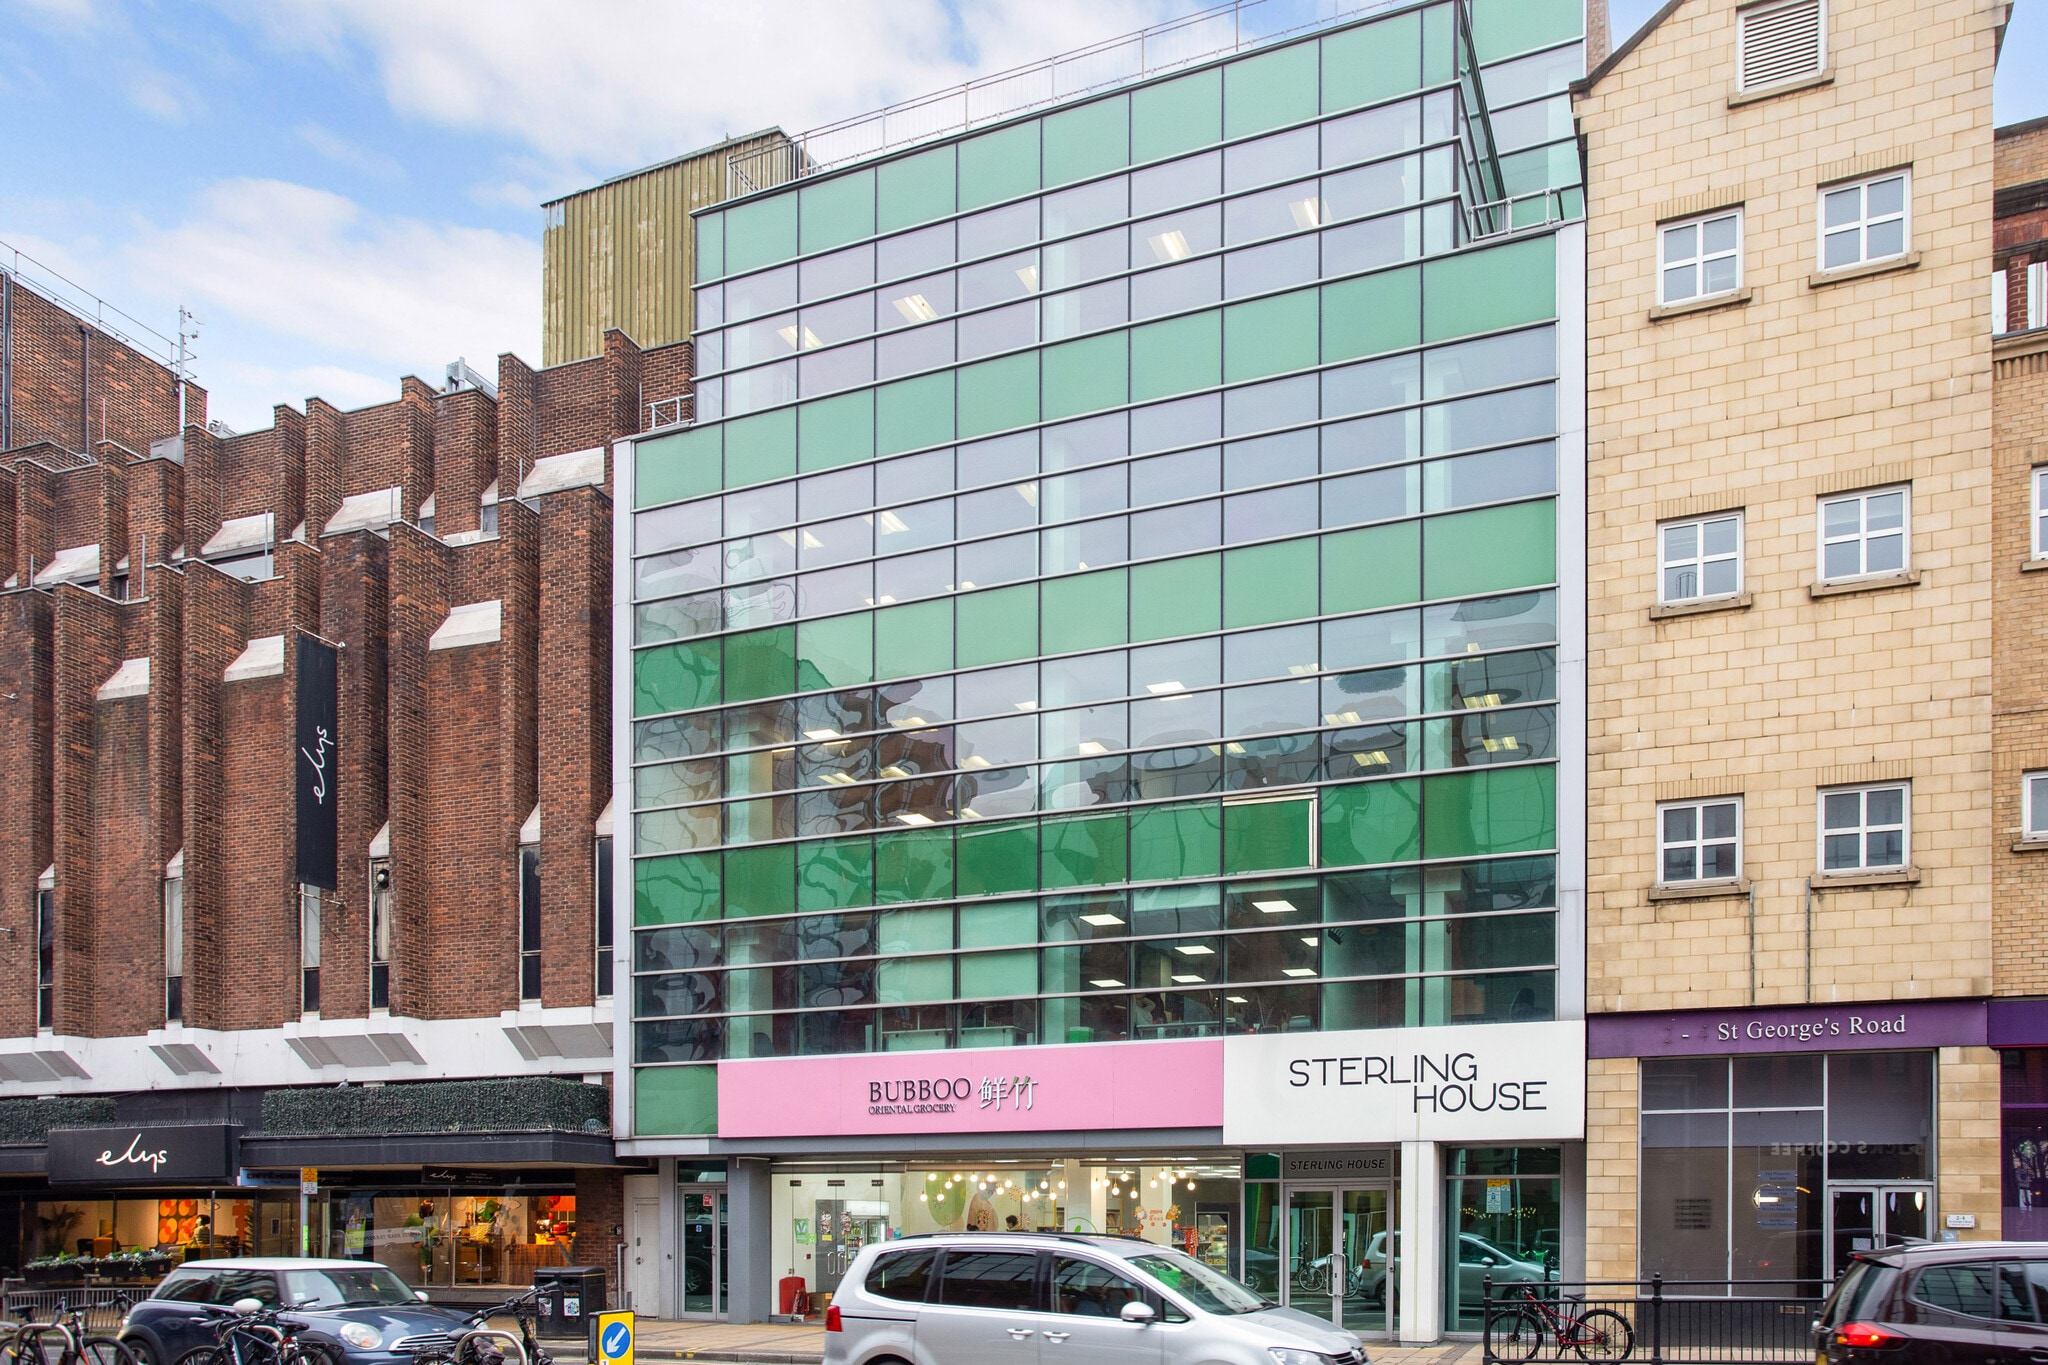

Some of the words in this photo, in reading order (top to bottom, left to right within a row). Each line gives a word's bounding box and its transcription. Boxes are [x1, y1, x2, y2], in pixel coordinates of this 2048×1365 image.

[301, 725, 335, 805] elys
[1718, 1022, 1739, 1041] St
[1746, 1018, 1840, 1042] George's
[1849, 1014, 1907, 1035] Road
[1289, 1053, 1478, 1087] STERLING
[869, 1077, 972, 1103] BUBBOO
[978, 1075, 1039, 1111] 鲜竹
[1413, 1081, 1548, 1113] HOUSE
[868, 1105, 913, 1115] ORIENTAL
[913, 1103, 956, 1114] GROCERY
[95, 1133, 168, 1174] elys
[1290, 1160, 1343, 1171] STERLING
[1347, 1158, 1386, 1169] HOUSE
